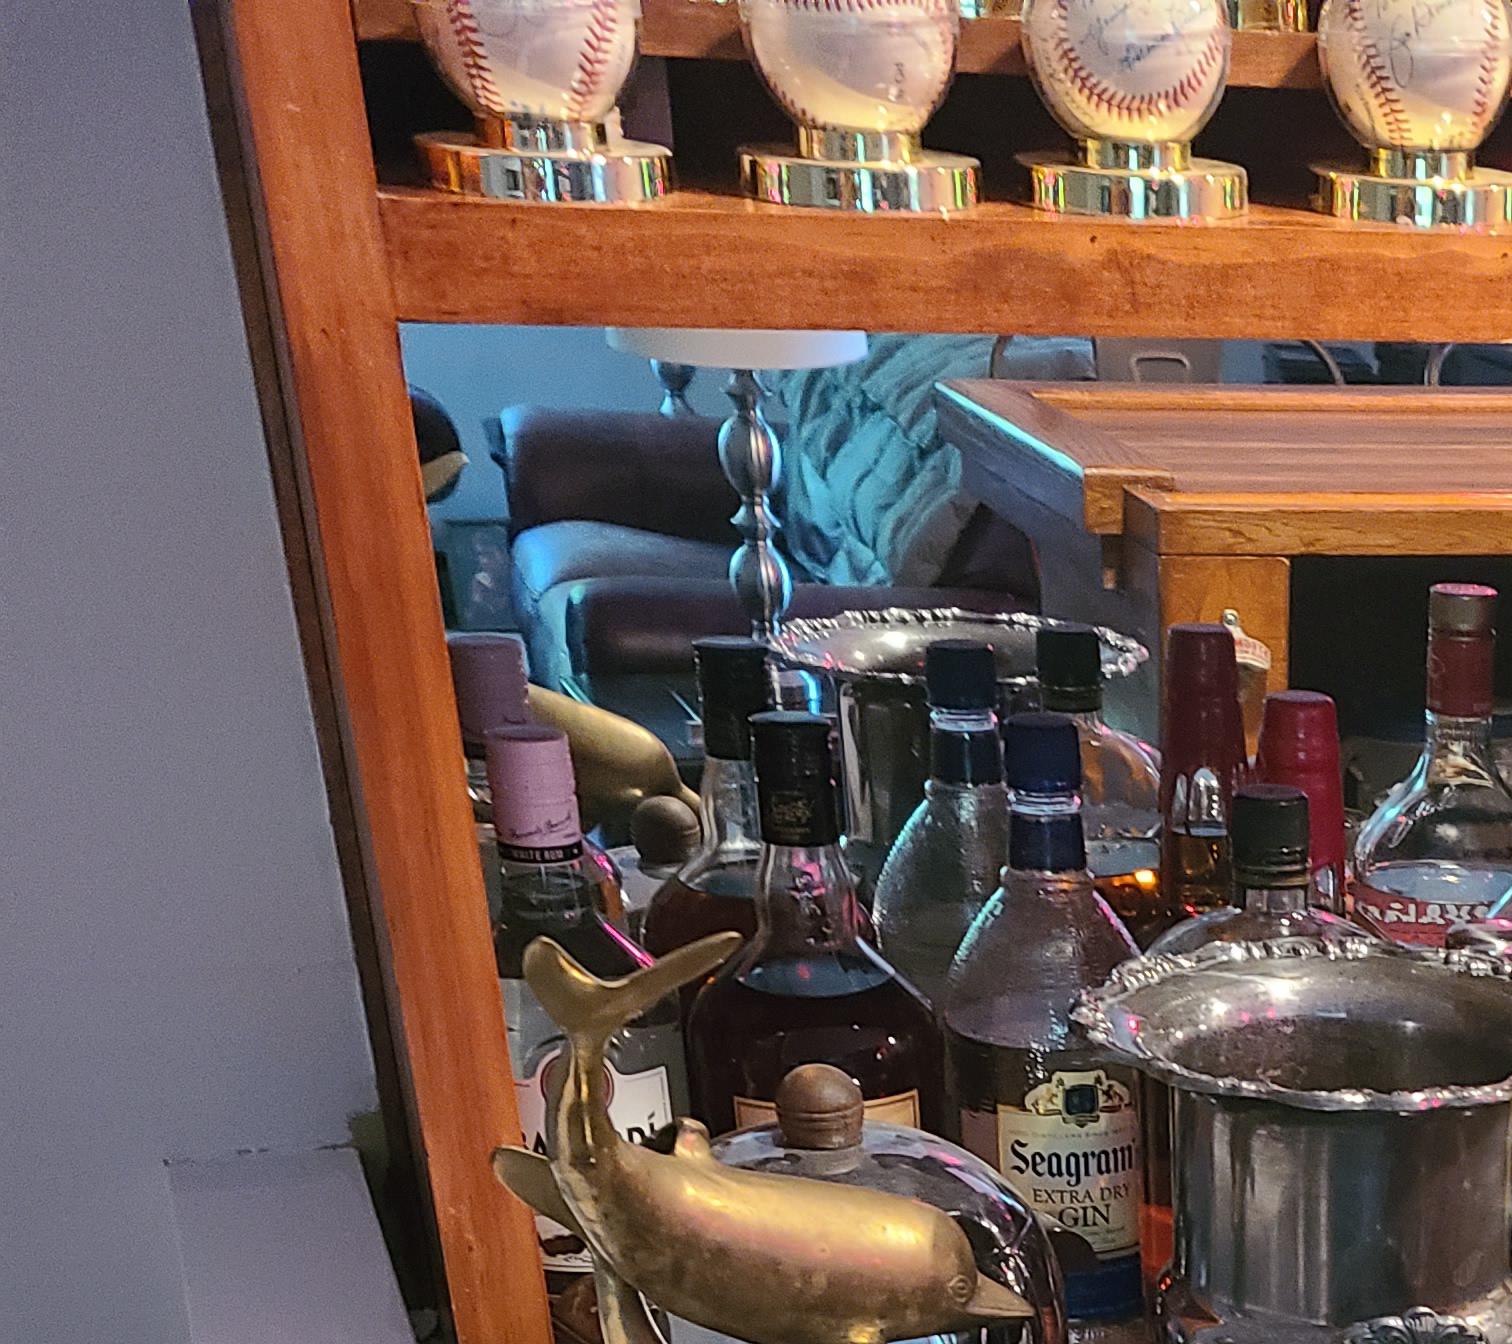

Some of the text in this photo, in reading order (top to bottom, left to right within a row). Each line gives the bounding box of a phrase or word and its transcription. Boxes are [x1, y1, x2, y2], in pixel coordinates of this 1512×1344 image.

[1033, 1183, 1129, 1204] EXTRA DRY
[1059, 1204, 1111, 1228] GIN
